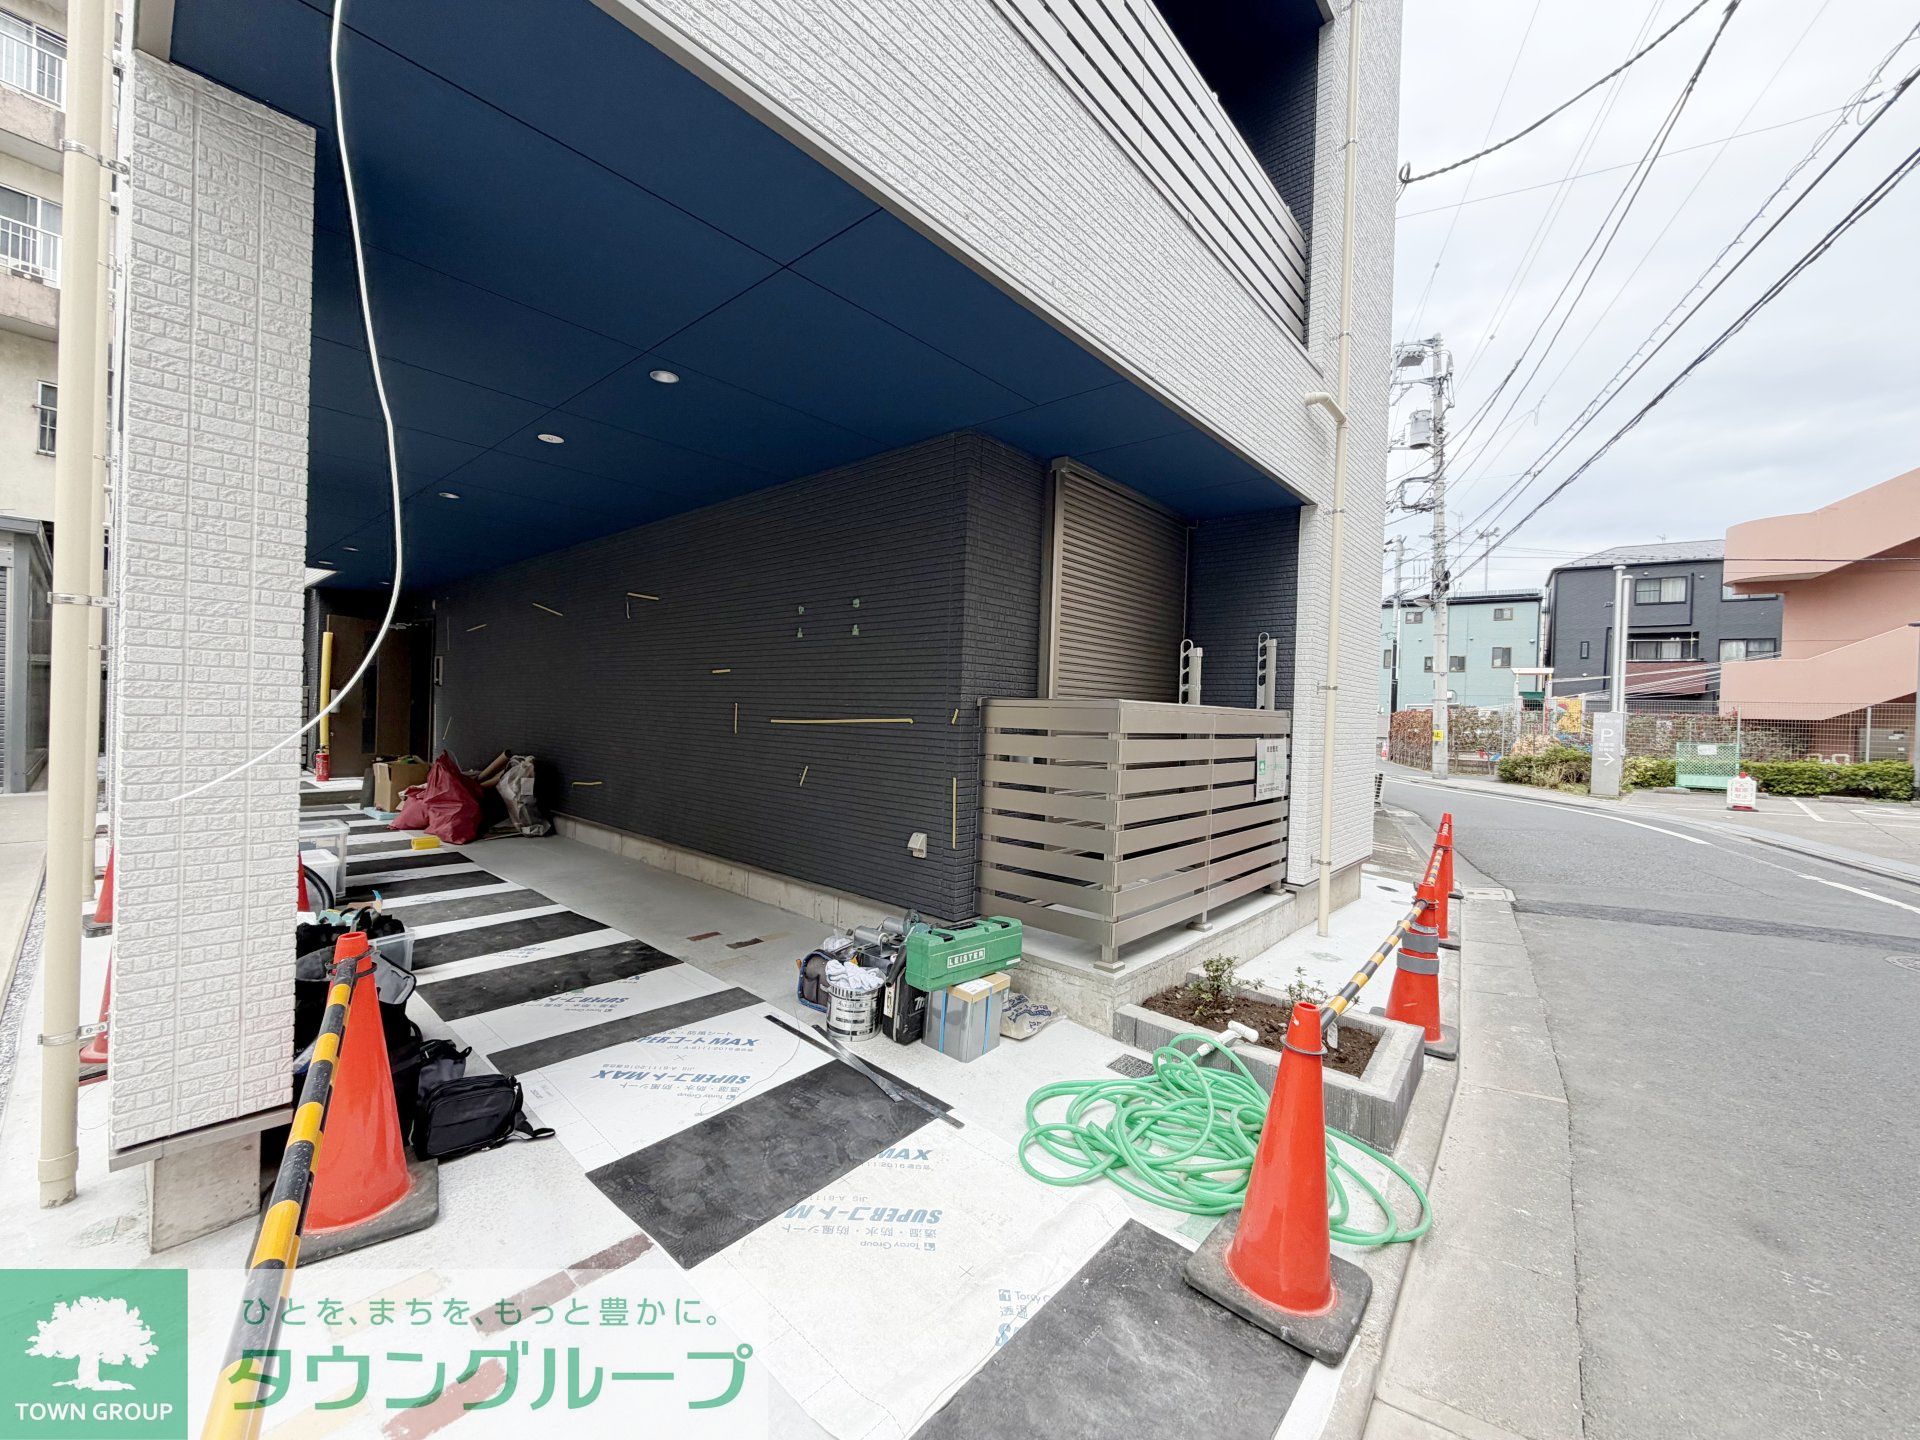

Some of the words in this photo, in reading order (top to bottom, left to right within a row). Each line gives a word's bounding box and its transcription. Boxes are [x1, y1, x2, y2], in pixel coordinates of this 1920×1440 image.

[1601, 728, 1614, 742] P
[949, 950, 984, 966] LEISTER
[860, 1240, 892, 1249] Group
[894, 1241, 919, 1250] Toray
